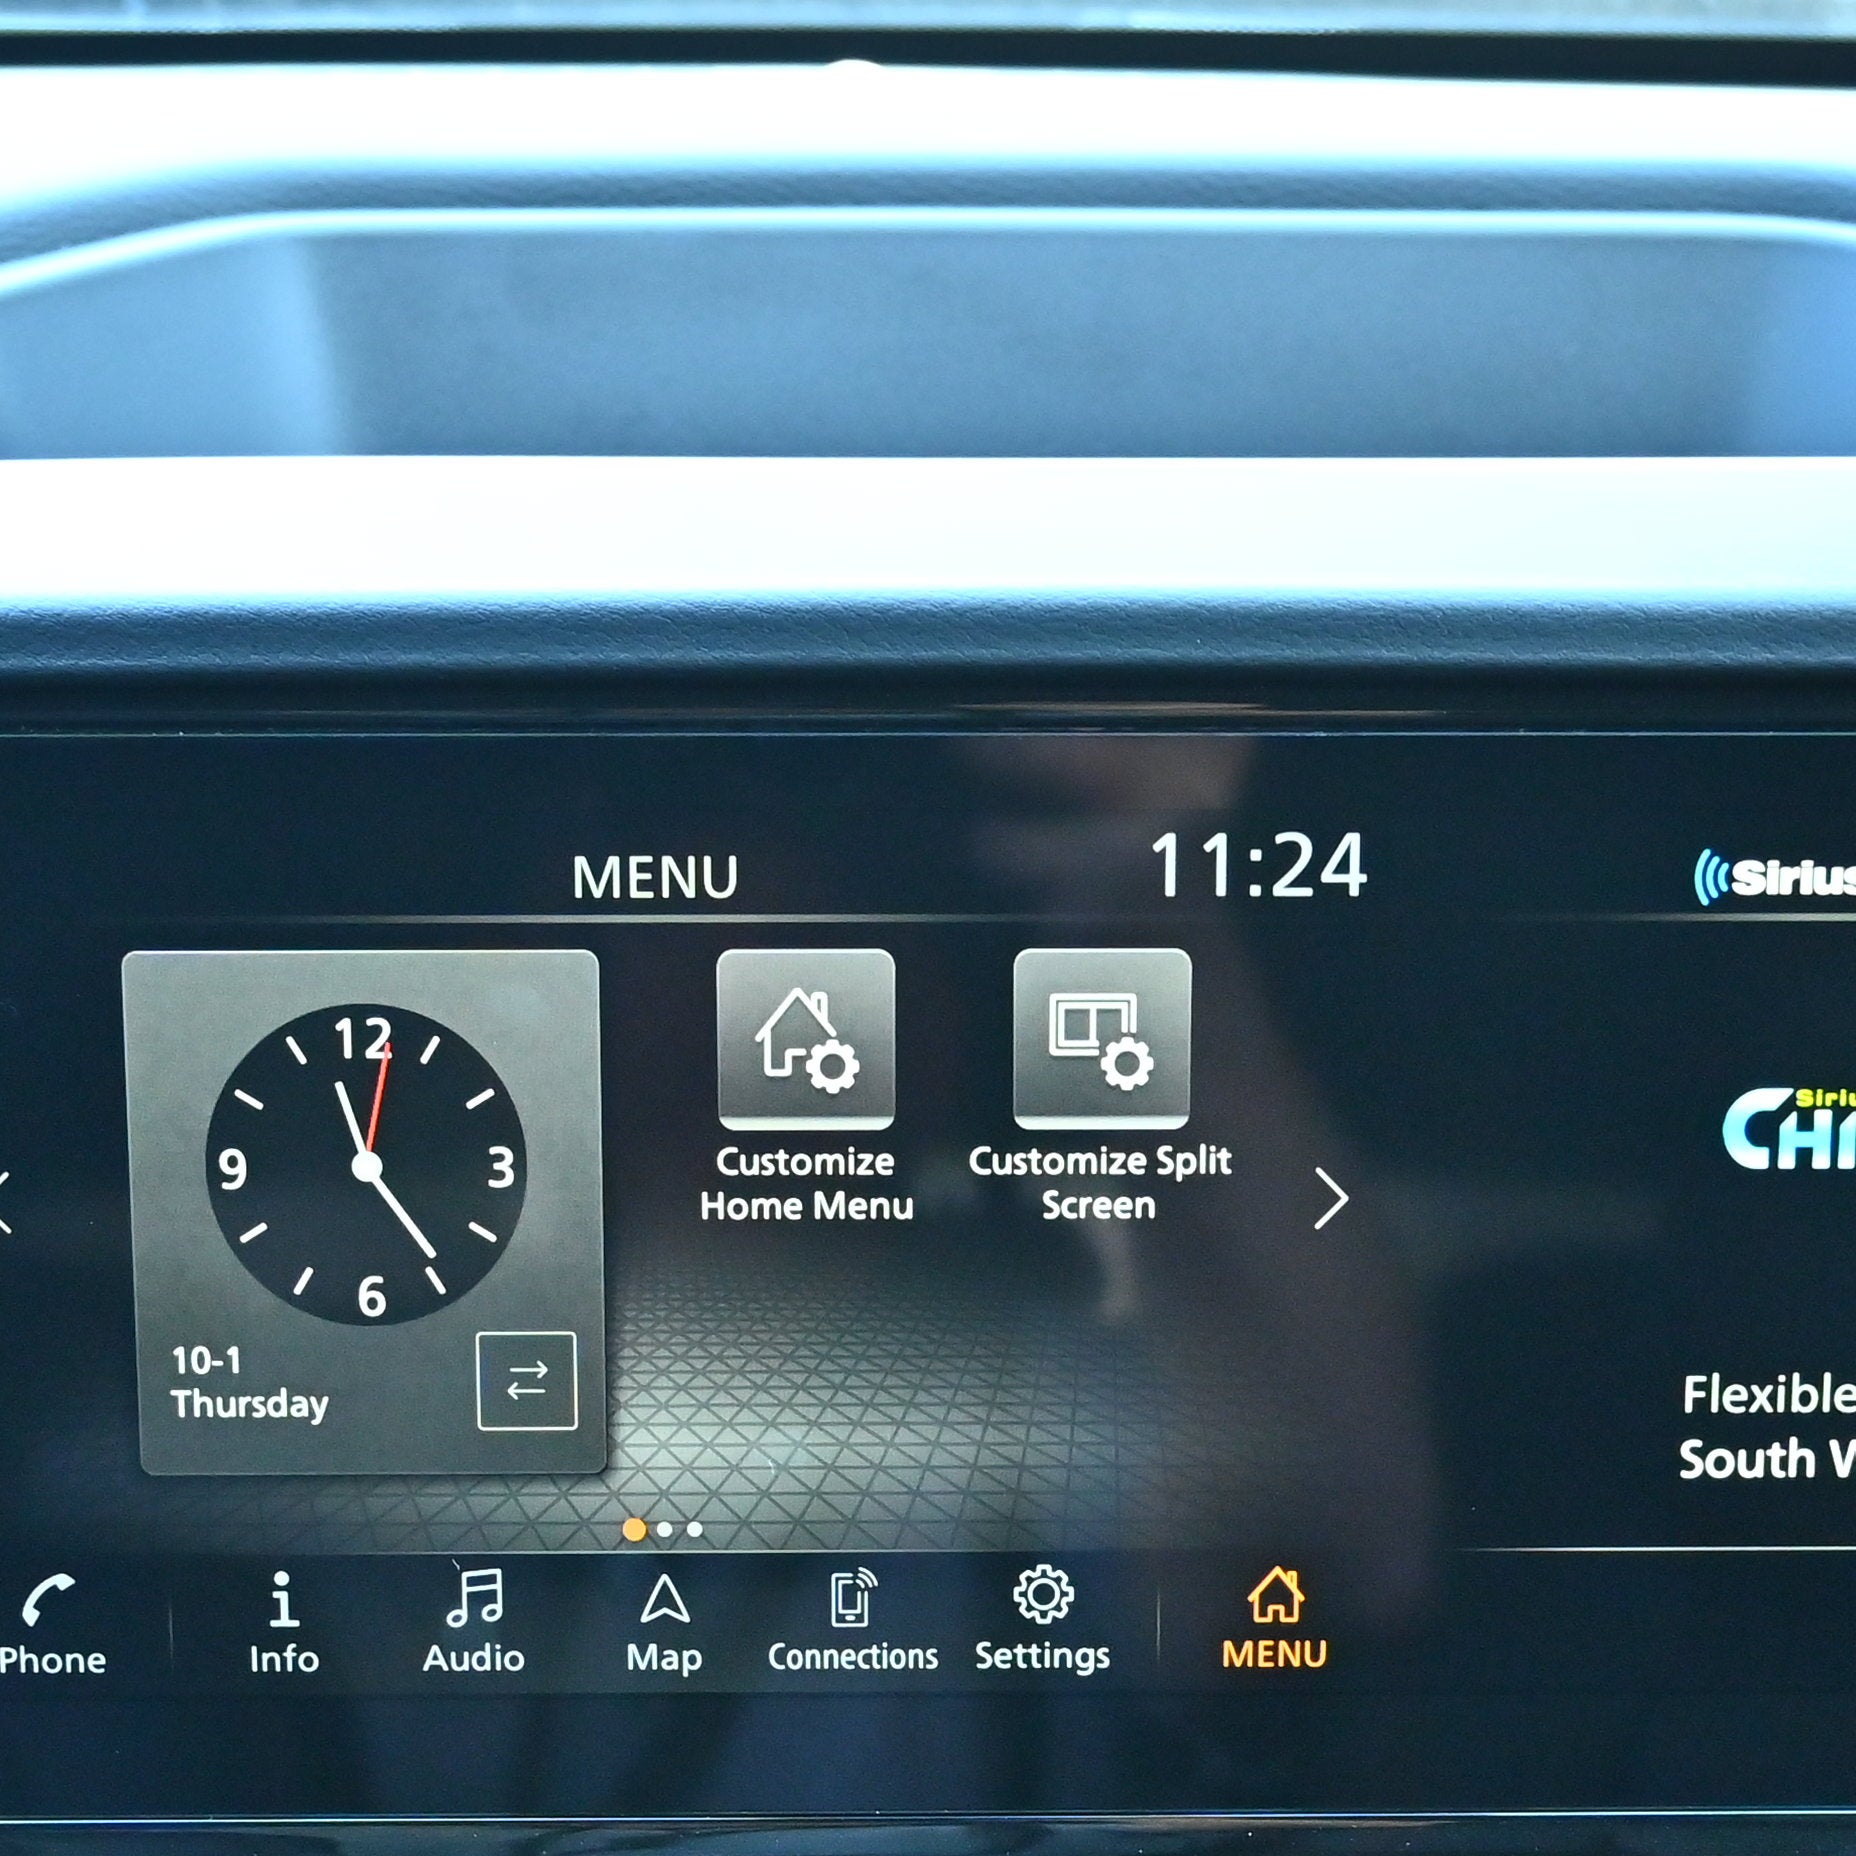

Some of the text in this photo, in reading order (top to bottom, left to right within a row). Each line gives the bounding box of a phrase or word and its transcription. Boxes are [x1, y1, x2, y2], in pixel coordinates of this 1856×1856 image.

[574, 855, 737, 899] MENU
[1152, 831, 1368, 898] 11:24
[334, 1012, 394, 1066] 12
[218, 1147, 247, 1191] 9
[487, 1145, 515, 1189] 3
[716, 1146, 895, 1177] Customize
[969, 1142, 1233, 1183] Customize Split
[701, 1190, 914, 1221] Home Menu
[1042, 1189, 1156, 1220] Screen
[358, 1275, 387, 1318] 6
[172, 1345, 240, 1375] 10-1
[169, 1386, 330, 1426] Thursday
[1679, 1435, 1816, 1480] South
[0, 1644, 107, 1674] Phone
[250, 1642, 320, 1673] Info
[422, 1641, 525, 1672] Audio
[627, 1643, 703, 1678] Map
[768, 1641, 939, 1671] Connections
[975, 1640, 1111, 1677] Settings
[1222, 1639, 1327, 1668] MENU
